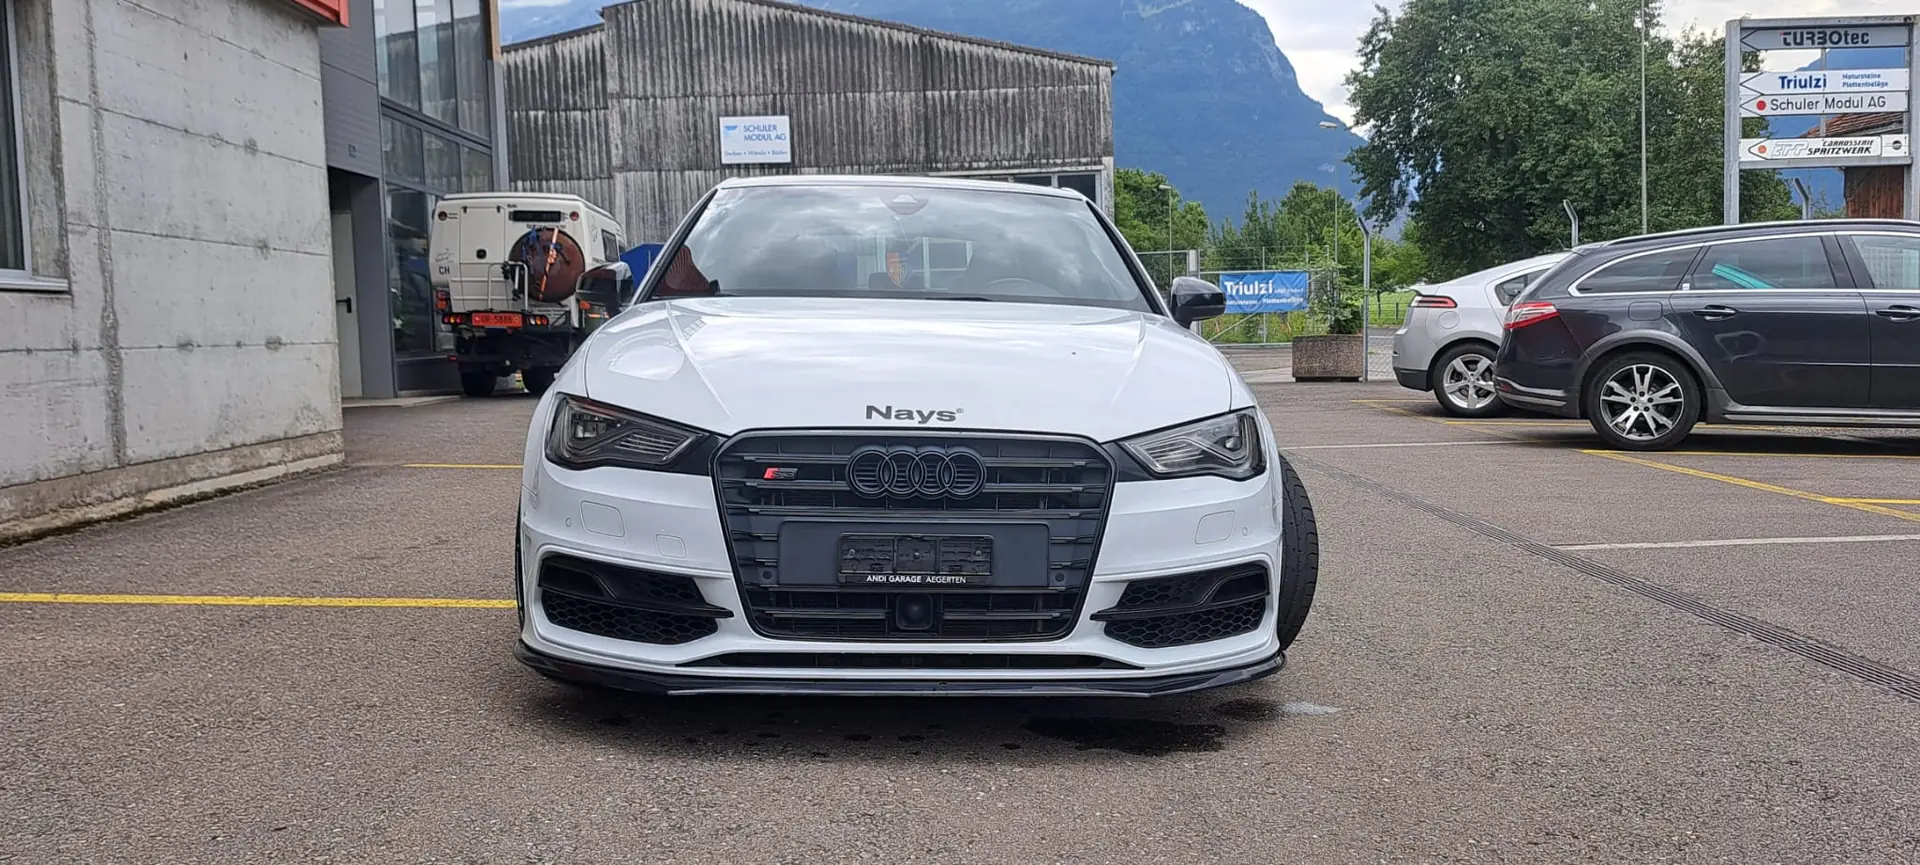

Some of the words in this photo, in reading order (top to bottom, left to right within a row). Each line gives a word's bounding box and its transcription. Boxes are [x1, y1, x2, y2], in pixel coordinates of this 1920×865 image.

[1842, 72, 1881, 80] Natursteine
[1778, 74, 1827, 90] Triulzi
[1770, 98, 1820, 112] Schuler
[1824, 97, 1863, 110] Modul
[1867, 96, 1886, 109] AG
[743, 124, 778, 132] SCHULER
[743, 133, 773, 141] MODUL
[774, 133, 787, 141] AG
[1807, 147, 1872, 156] SPRITZWERK
[438, 265, 450, 275] CH
[1224, 280, 1273, 295] Triulzi
[866, 575, 886, 583] ANDI
[888, 575, 922, 583] GARAGE
[925, 576, 966, 584] AEGERTEN
